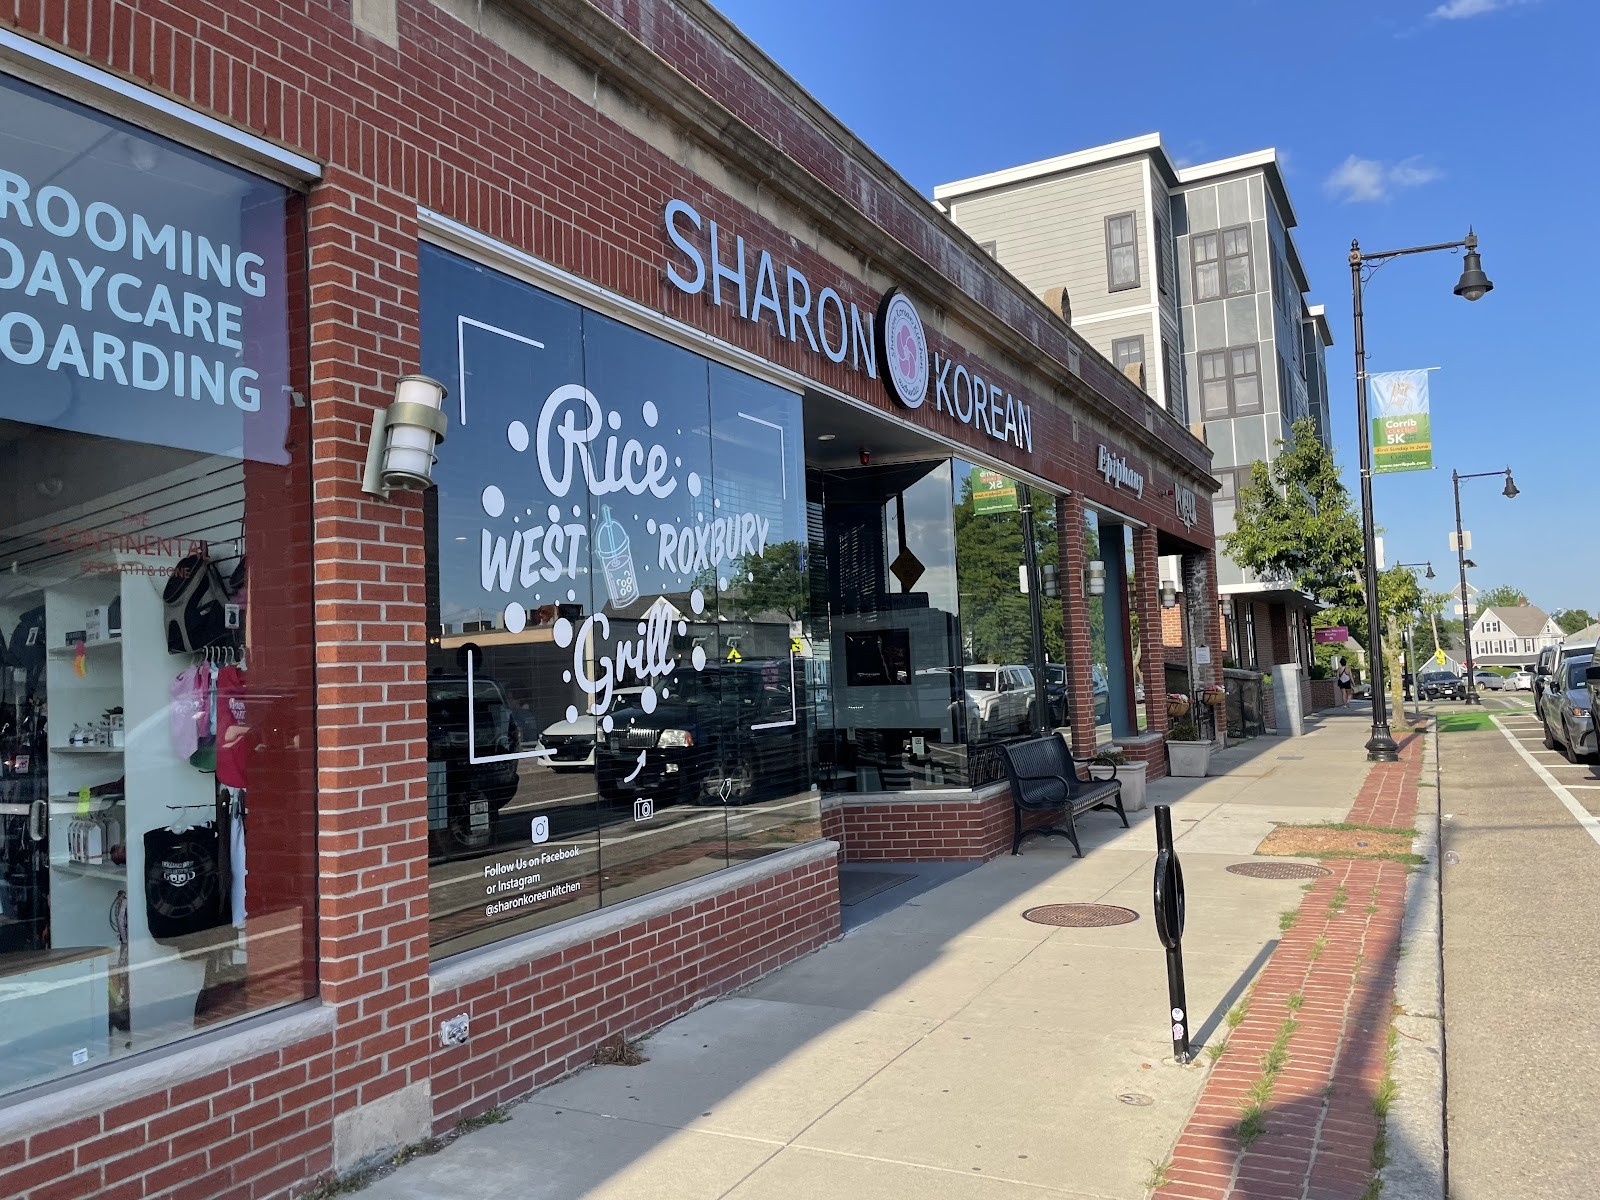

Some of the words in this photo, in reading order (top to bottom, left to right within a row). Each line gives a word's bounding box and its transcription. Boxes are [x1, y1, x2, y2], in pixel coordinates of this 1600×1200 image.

[0, 168, 266, 297] ROOMING
[0, 237, 243, 350] DAYCARE
[664, 199, 877, 379] SHARON
[0, 311, 261, 412] OARDING
[934, 350, 1032, 453] KOREAN
[536, 383, 678, 498] Rice
[1385, 418, 1417, 428] Corrib
[1387, 433, 1405, 444] 5K
[1097, 443, 1144, 499] Epiphany
[481, 523, 587, 593] WEST
[657, 512, 770, 575] ROXBURY
[574, 604, 675, 715] Grill
[484, 862, 515, 878] Follow
[515, 858, 528, 870] Us
[528, 857, 540, 867] on
[541, 845, 580, 864] Facebook
[485, 881, 581, 917] @sharonkoreankitchen
[486, 884, 497, 895] or
[498, 873, 541, 892] Instagram
